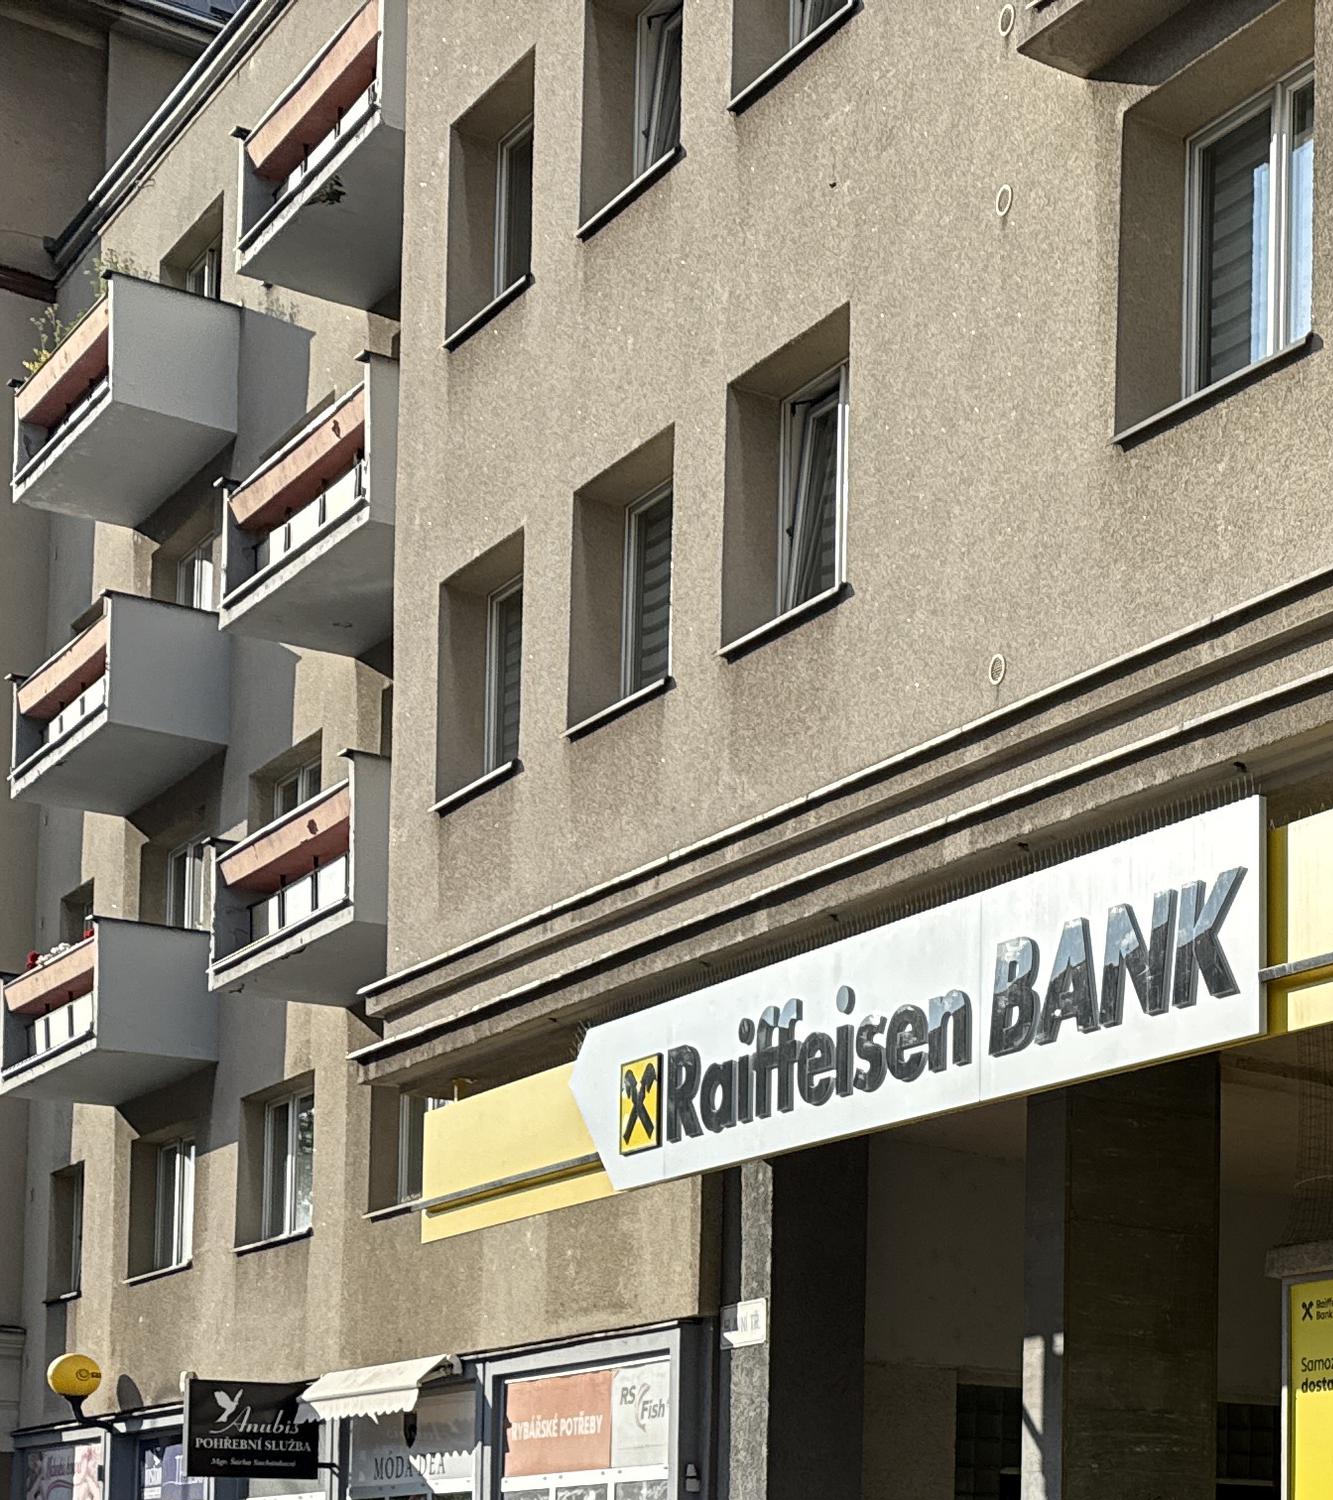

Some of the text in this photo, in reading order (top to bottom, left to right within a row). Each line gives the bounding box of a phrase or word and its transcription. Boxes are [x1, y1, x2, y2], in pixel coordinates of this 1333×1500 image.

[666, 864, 1248, 1143] Raiffeisen BANK
[1316, 1310, 1333, 1321] Bank
[620, 1385, 665, 1420] RS Fish
[209, 1405, 300, 1435] Anubis
[511, 1410, 603, 1441] RYBÁŘSKÉ POTŘEBY
[195, 1436, 311, 1453] POHŘEBNÍ SLUŽBA
[373, 1450, 446, 1481] MÓDA DEA
